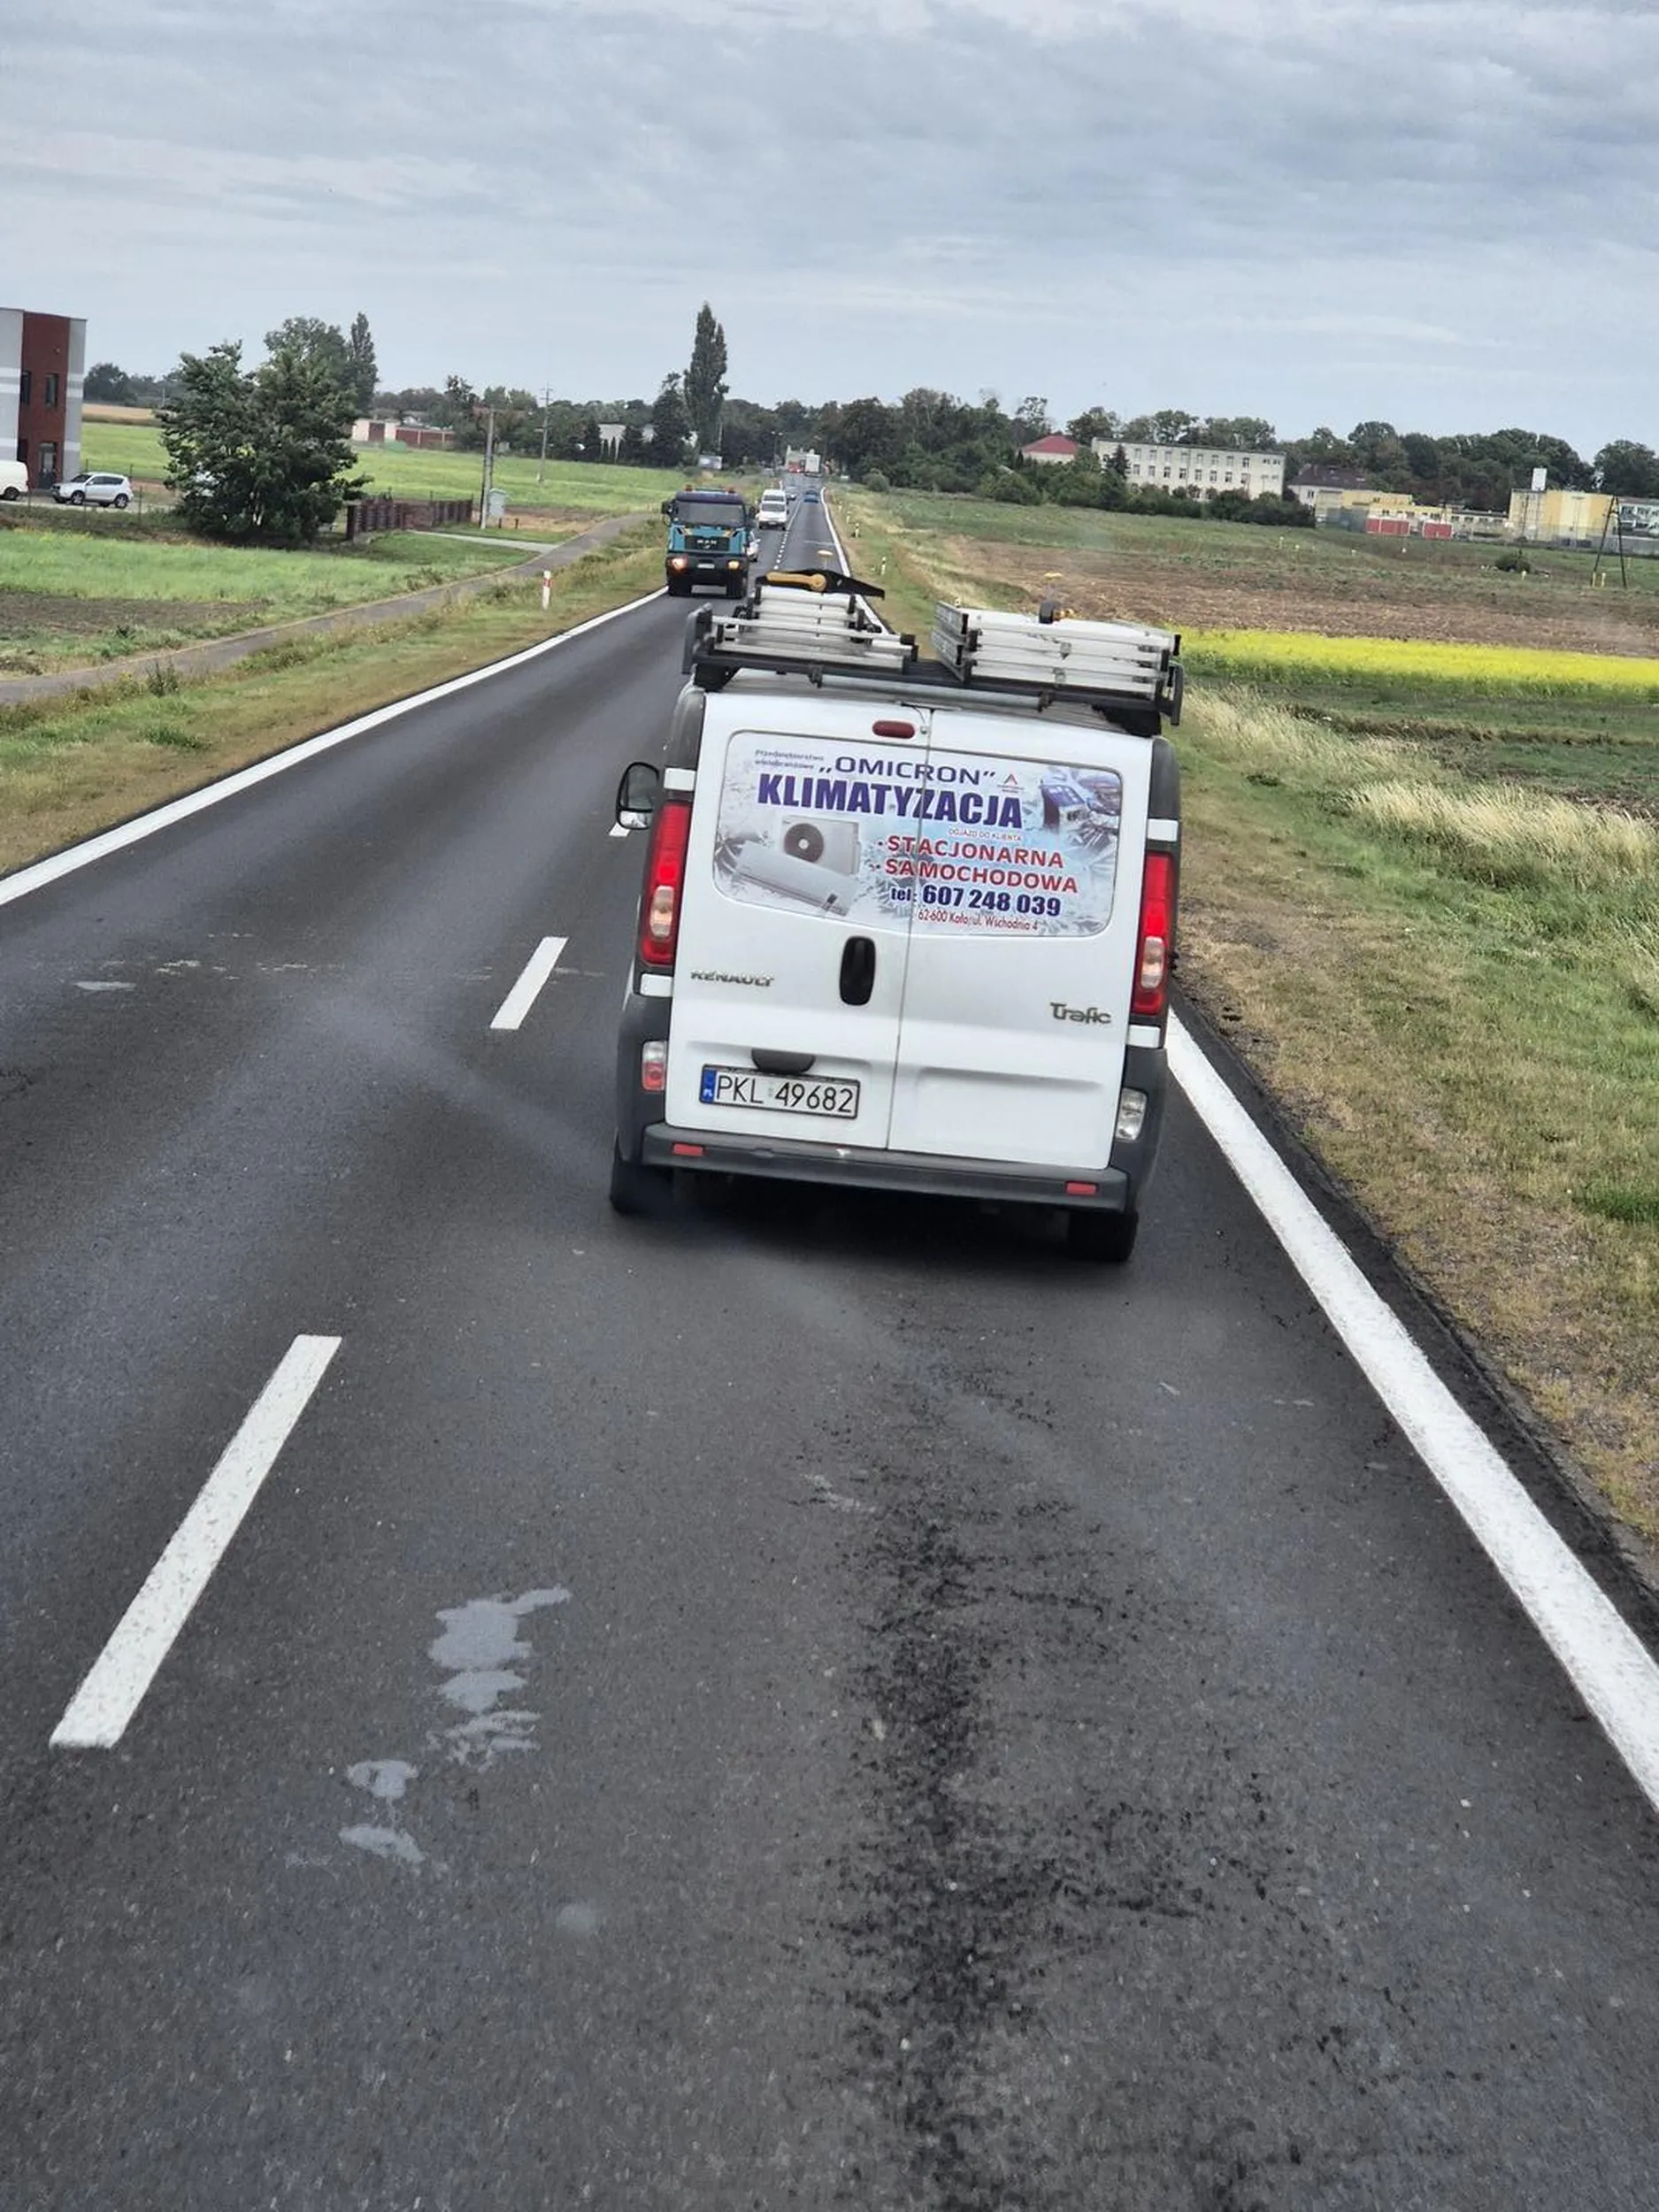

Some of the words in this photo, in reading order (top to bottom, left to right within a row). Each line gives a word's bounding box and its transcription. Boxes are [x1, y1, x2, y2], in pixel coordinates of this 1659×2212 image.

[757, 773, 1022, 829] KLIMATYZACJA
[887, 835, 1064, 868] STACJONARNA
[886, 858, 1079, 893] SAMOCHODOWA
[923, 885, 964, 907] 607
[969, 889, 1010, 912] 248
[1017, 894, 1062, 917] 039
[918, 909, 948, 923] 62-600
[986, 916, 1031, 930] Wschodnia
[690, 971, 774, 987] RENAULT
[1049, 1001, 1112, 1025] Trafic
[716, 1074, 764, 1104] PKL
[774, 1081, 854, 1113] 49682
